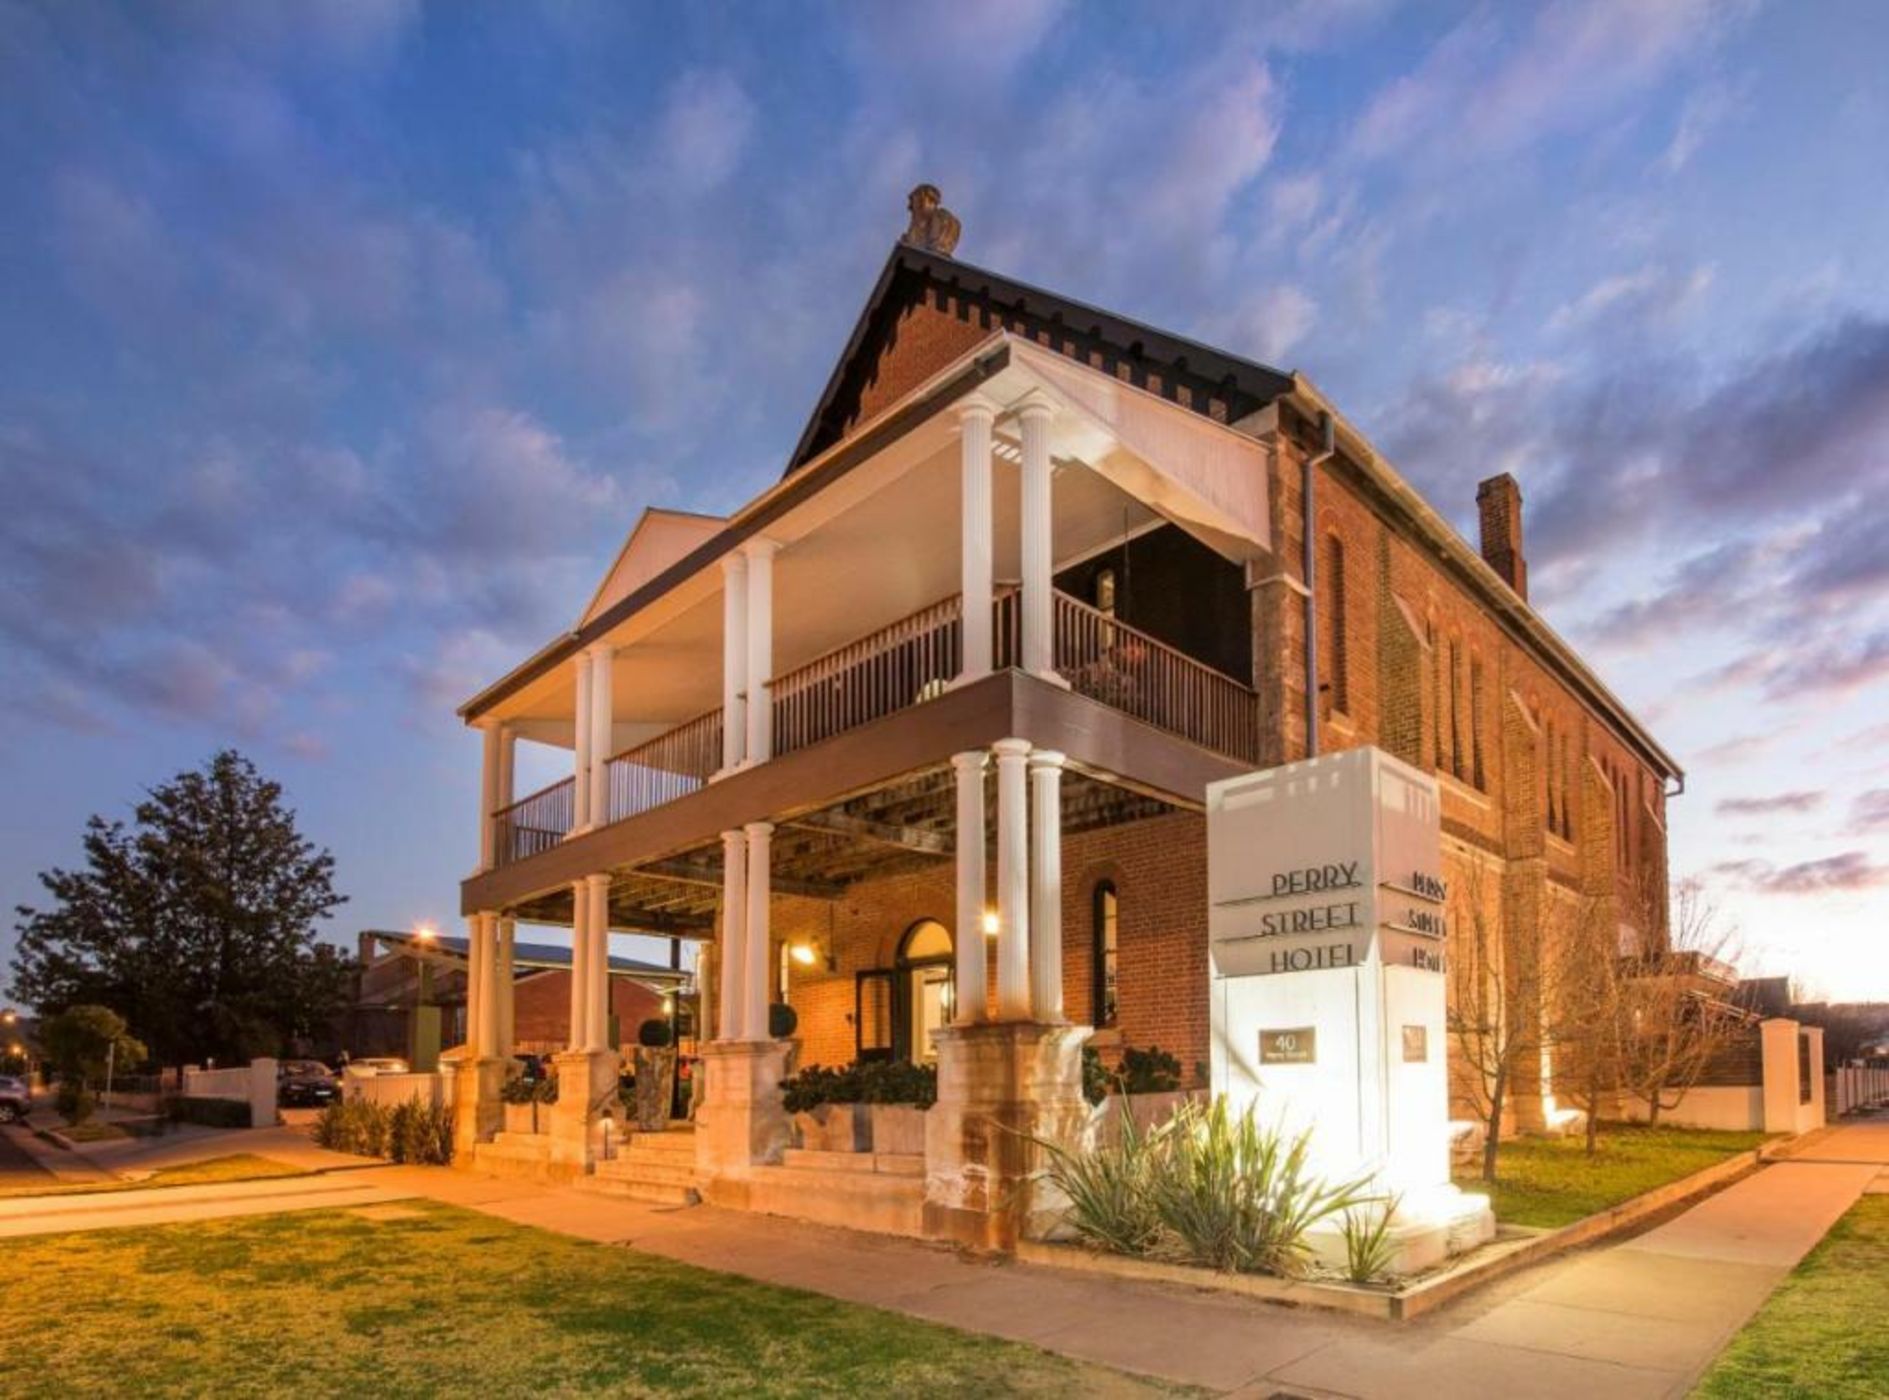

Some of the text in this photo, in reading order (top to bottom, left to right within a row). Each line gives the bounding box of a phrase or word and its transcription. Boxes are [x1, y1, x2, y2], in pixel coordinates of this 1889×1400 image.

[1272, 861, 1358, 896] PERRY
[1261, 902, 1360, 936] STREET
[1271, 944, 1357, 973] HOTEL
[1275, 1034, 1296, 1051] 40
